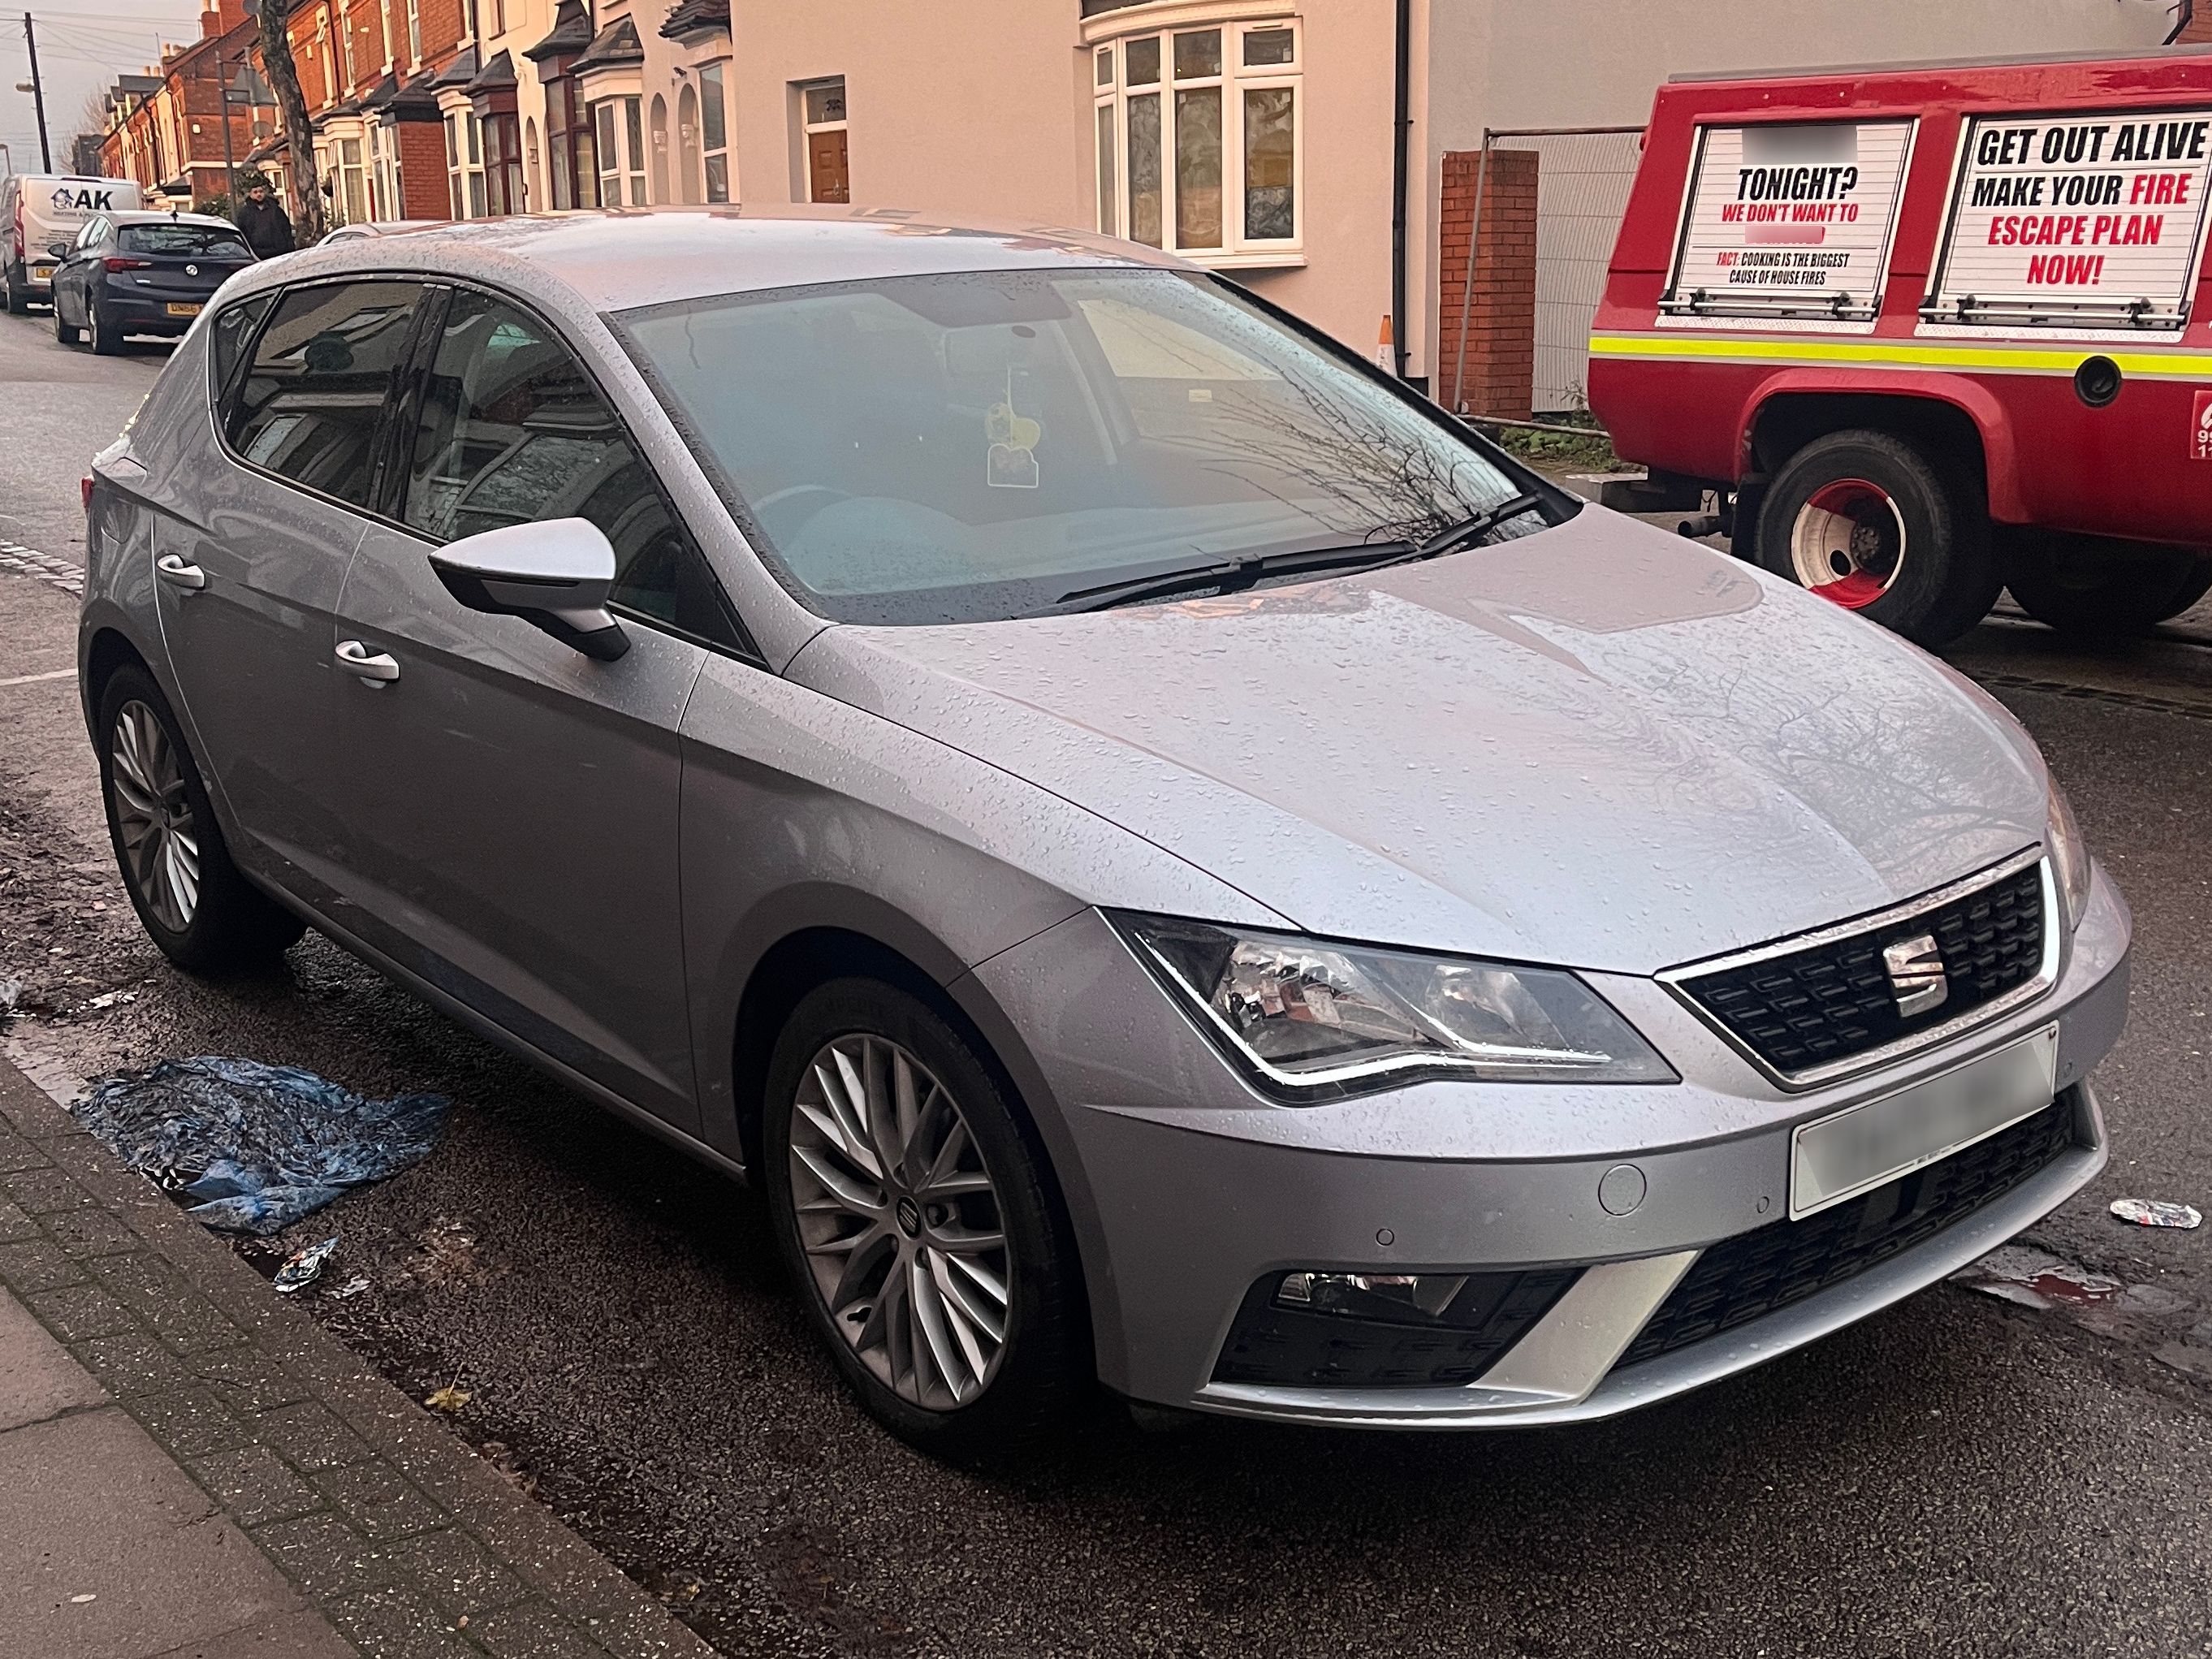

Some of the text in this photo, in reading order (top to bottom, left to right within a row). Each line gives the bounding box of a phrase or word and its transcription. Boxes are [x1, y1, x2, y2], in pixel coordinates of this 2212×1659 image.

[1977, 122, 2210, 166] GET OUT ALIVE
[1737, 167, 1858, 201] TONIGHT?
[1971, 173, 2193, 207] MAKE YOUR FIRE
[74, 189, 113, 210] AK
[1722, 204, 1858, 222] WE DON'T WANT TO
[1988, 214, 2164, 245] ESCAPE PLAN
[1717, 253, 1850, 268] FACT: COOKING IS THE BIGGEST
[2027, 255, 2105, 284] NOW!
[1729, 270, 1826, 285] CAUSE OF HOUSE FIRES
[2197, 430, 2212, 443] 9
